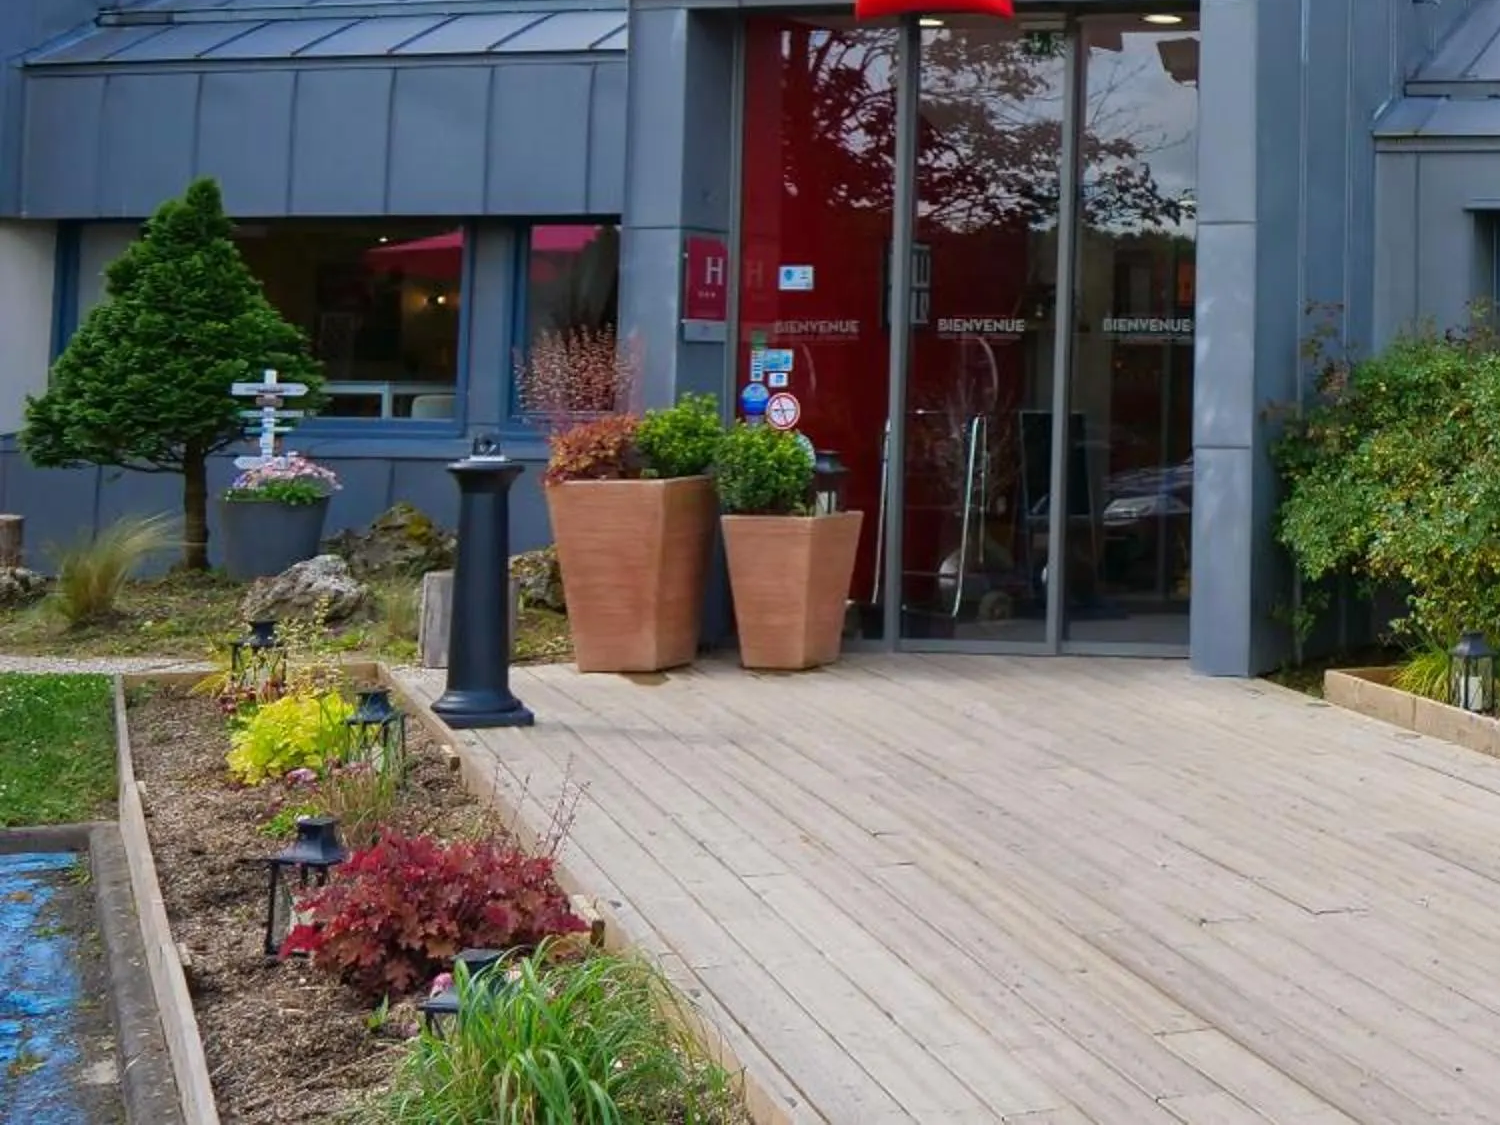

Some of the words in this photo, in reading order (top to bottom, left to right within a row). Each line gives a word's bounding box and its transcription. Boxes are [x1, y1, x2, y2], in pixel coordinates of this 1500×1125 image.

[705, 256, 725, 286] H
[775, 319, 860, 334] BIENVENUE
[937, 318, 1025, 332] BIENVENUE
[1103, 318, 1192, 332] BIENVENUE
